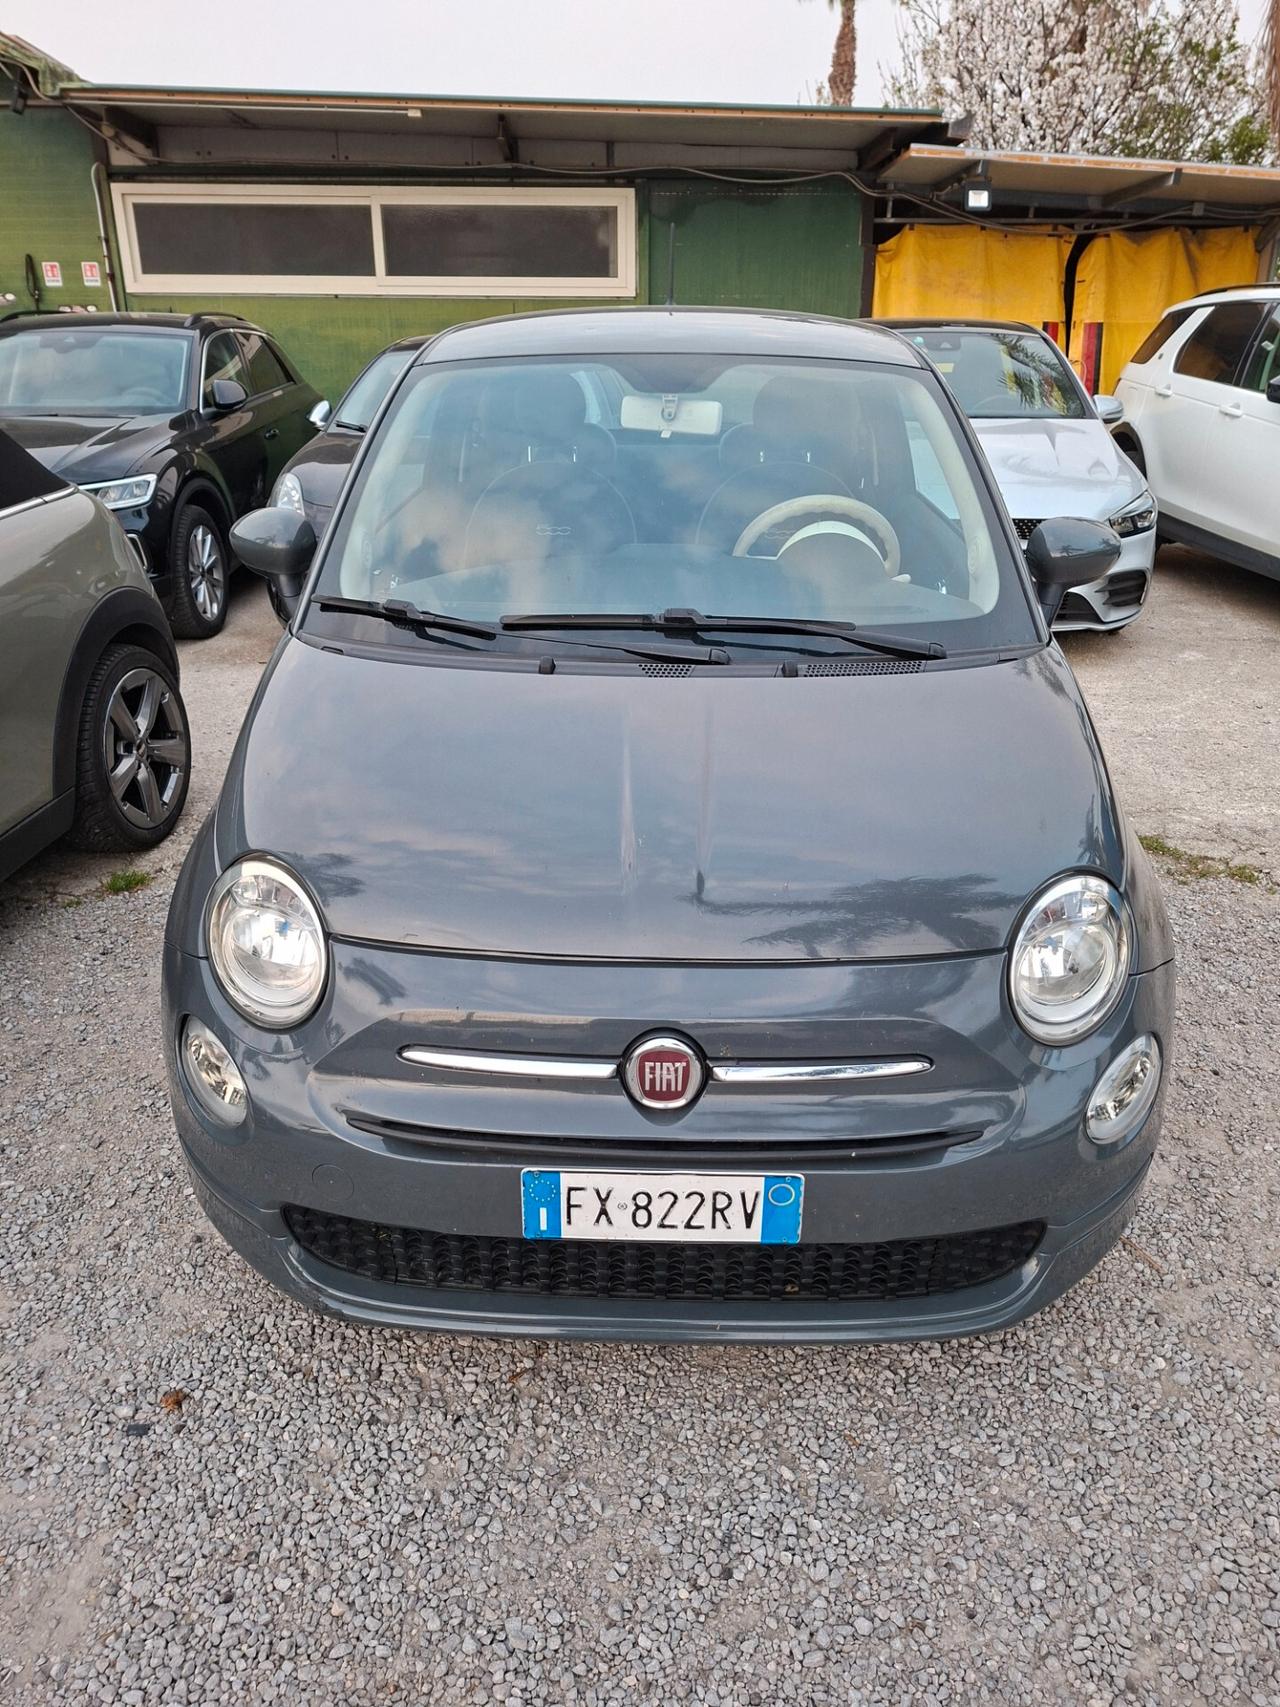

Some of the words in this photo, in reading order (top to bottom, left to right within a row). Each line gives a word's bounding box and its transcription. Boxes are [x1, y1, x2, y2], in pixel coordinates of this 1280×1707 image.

[644, 1061, 687, 1092] FIAT
[565, 1186, 614, 1226] FX
[631, 1191, 760, 1230] 822RV
